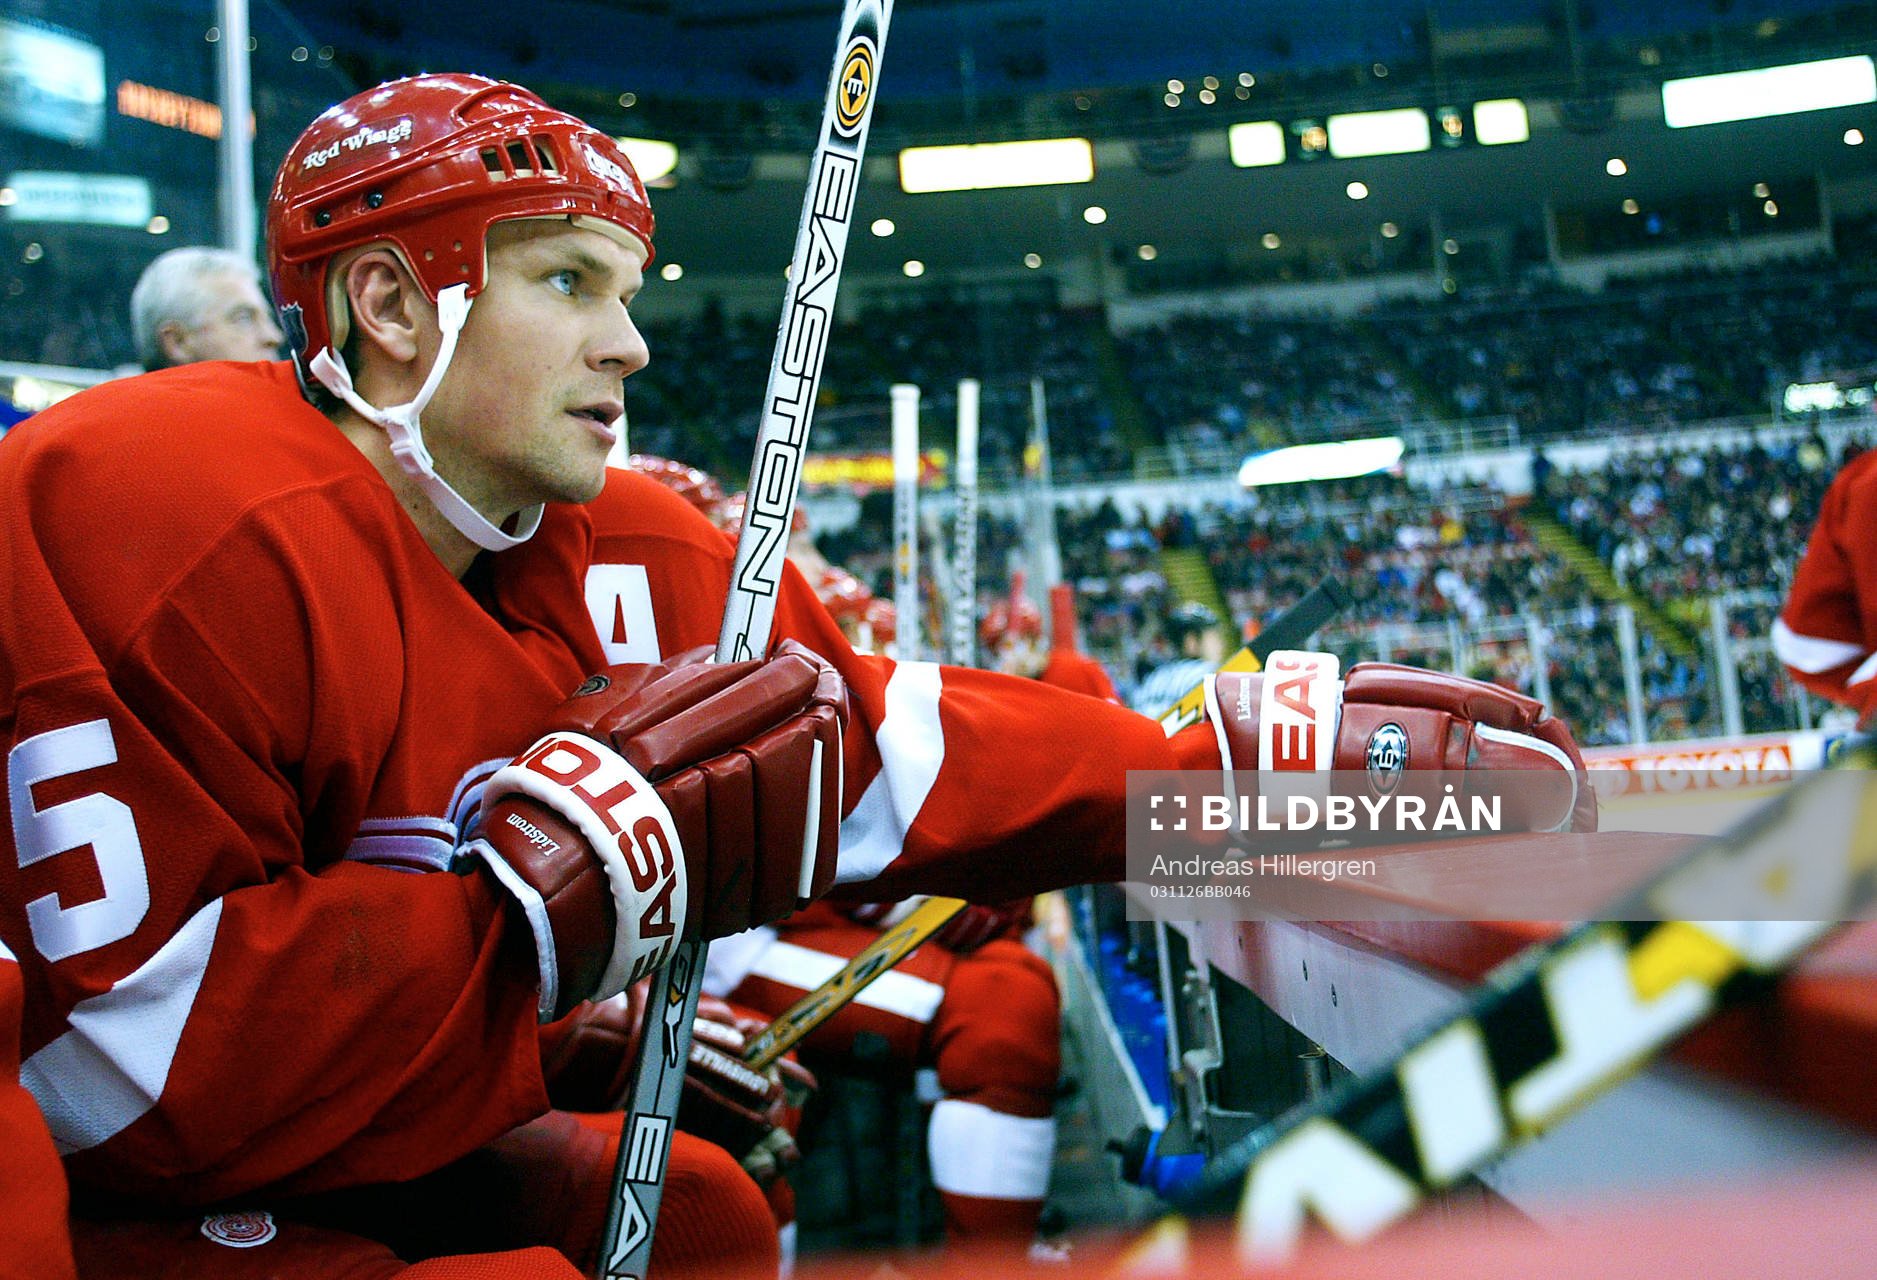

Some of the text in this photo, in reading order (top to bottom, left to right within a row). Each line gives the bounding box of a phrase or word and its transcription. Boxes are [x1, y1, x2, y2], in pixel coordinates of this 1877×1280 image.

[303, 120, 412, 169] Red Wings
[737, 150, 858, 598] EASTON
[584, 563, 662, 666] A
[1632, 746, 1792, 794] TOYOTA
[8, 718, 151, 963] 5
[506, 813, 561, 857] Lidstrom
[606, 1112, 672, 1280] EA
